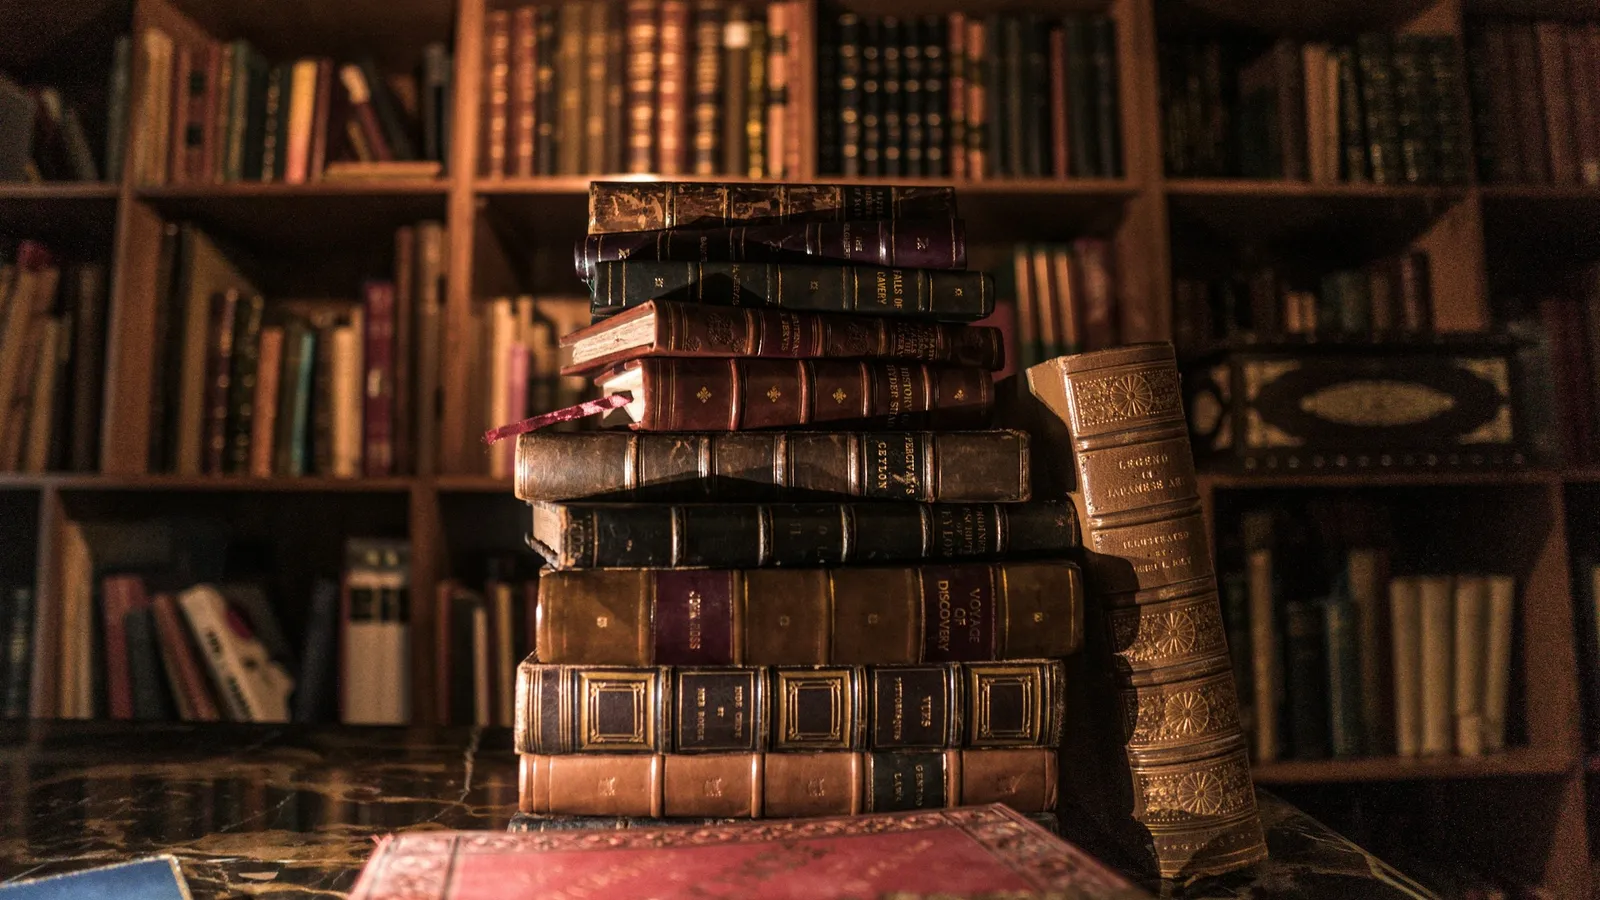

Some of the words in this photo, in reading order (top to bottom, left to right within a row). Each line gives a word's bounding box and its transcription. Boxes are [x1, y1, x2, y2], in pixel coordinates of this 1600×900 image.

[876, 271, 887, 305] CAVERY
[892, 269, 903, 295] FALLS
[893, 298, 904, 309] OF
[781, 320, 789, 352] JERVIS
[900, 367, 912, 412] HISTORY
[878, 440, 888, 490] CEYLON
[904, 434, 915, 496] PERCIVAL'S
[1118, 455, 1169, 470] LEGEND
[1107, 480, 1164, 498] JAPANESE
[938, 580, 950, 652] DISCOVERY
[953, 607, 967, 627] OF
[969, 587, 982, 645] VOYAGE
[920, 695, 932, 728] VUES
